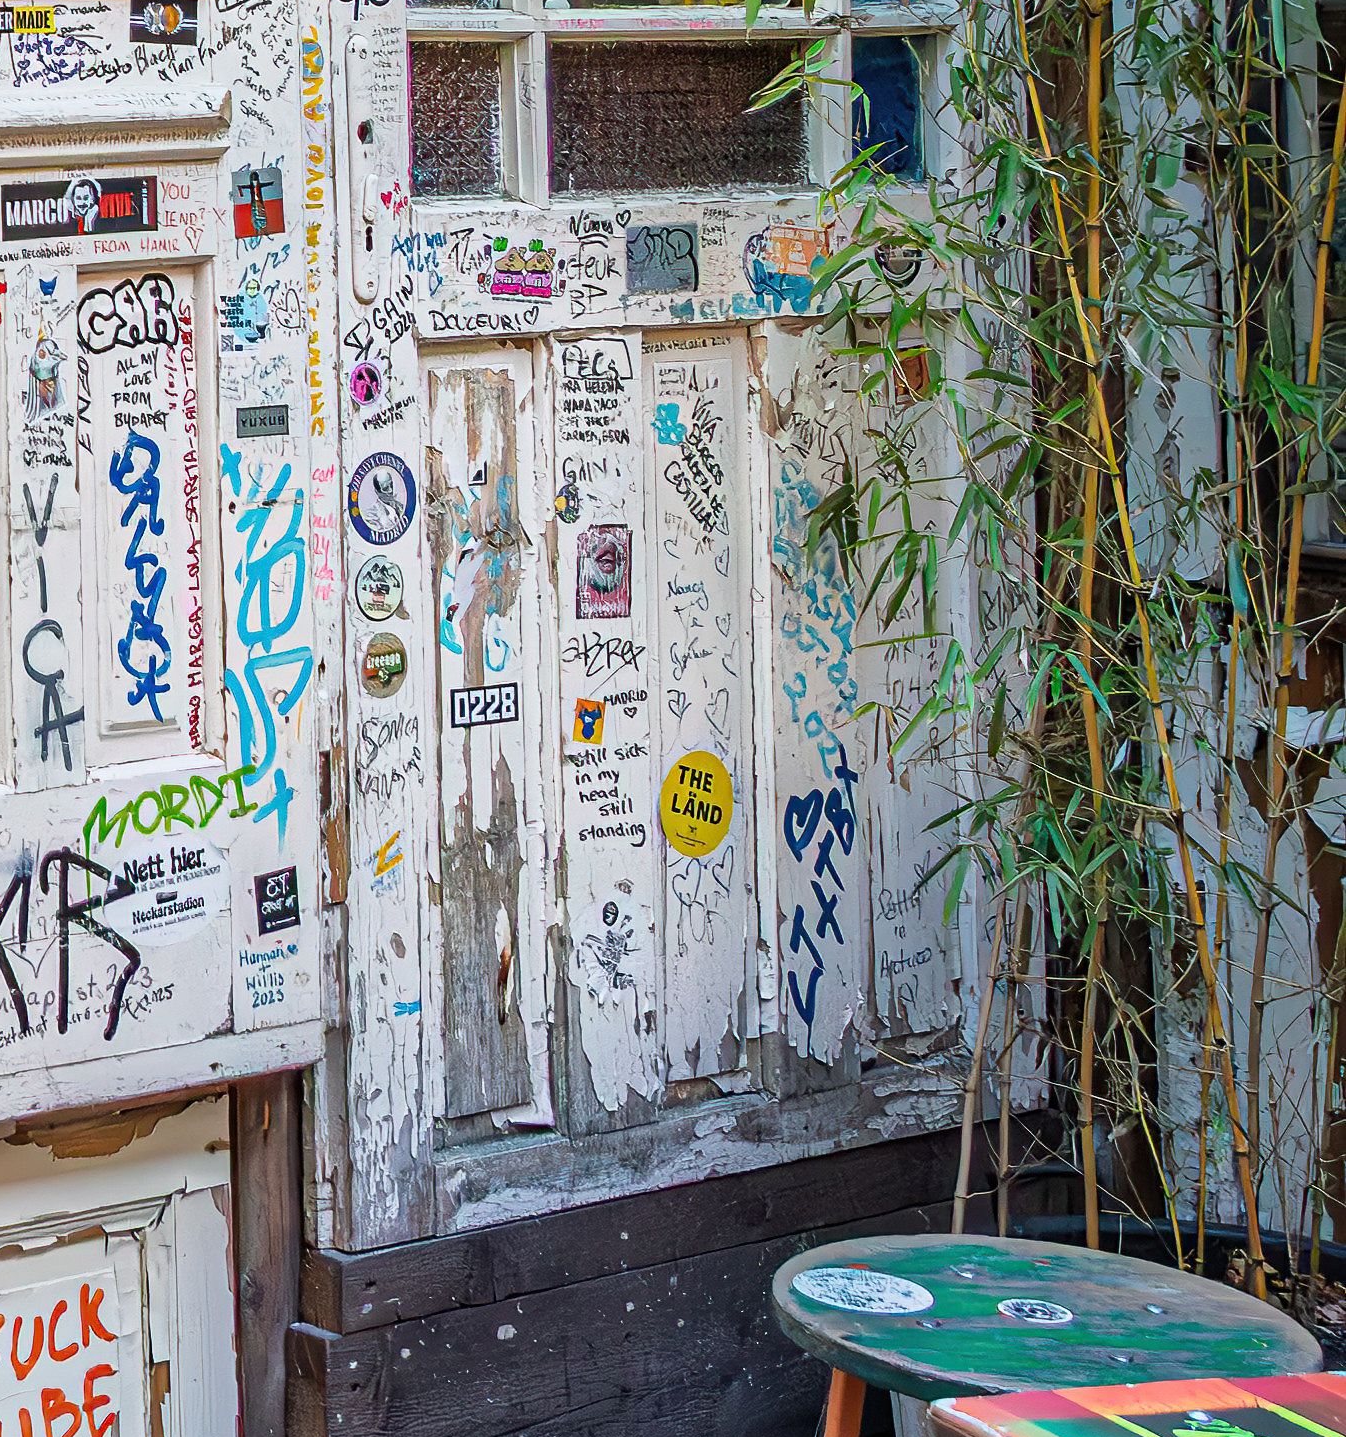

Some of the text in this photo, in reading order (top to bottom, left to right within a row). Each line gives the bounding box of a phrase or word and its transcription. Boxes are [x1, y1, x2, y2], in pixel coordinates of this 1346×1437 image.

[15, 8, 52, 31] MADE
[5, 196, 66, 227] MARCO
[453, 689, 520, 722] 0228
[678, 764, 714, 796] THE
[670, 787, 723, 827] LÄND
[578, 823, 646, 847] standing
[124, 845, 206, 883] Nett hier.
